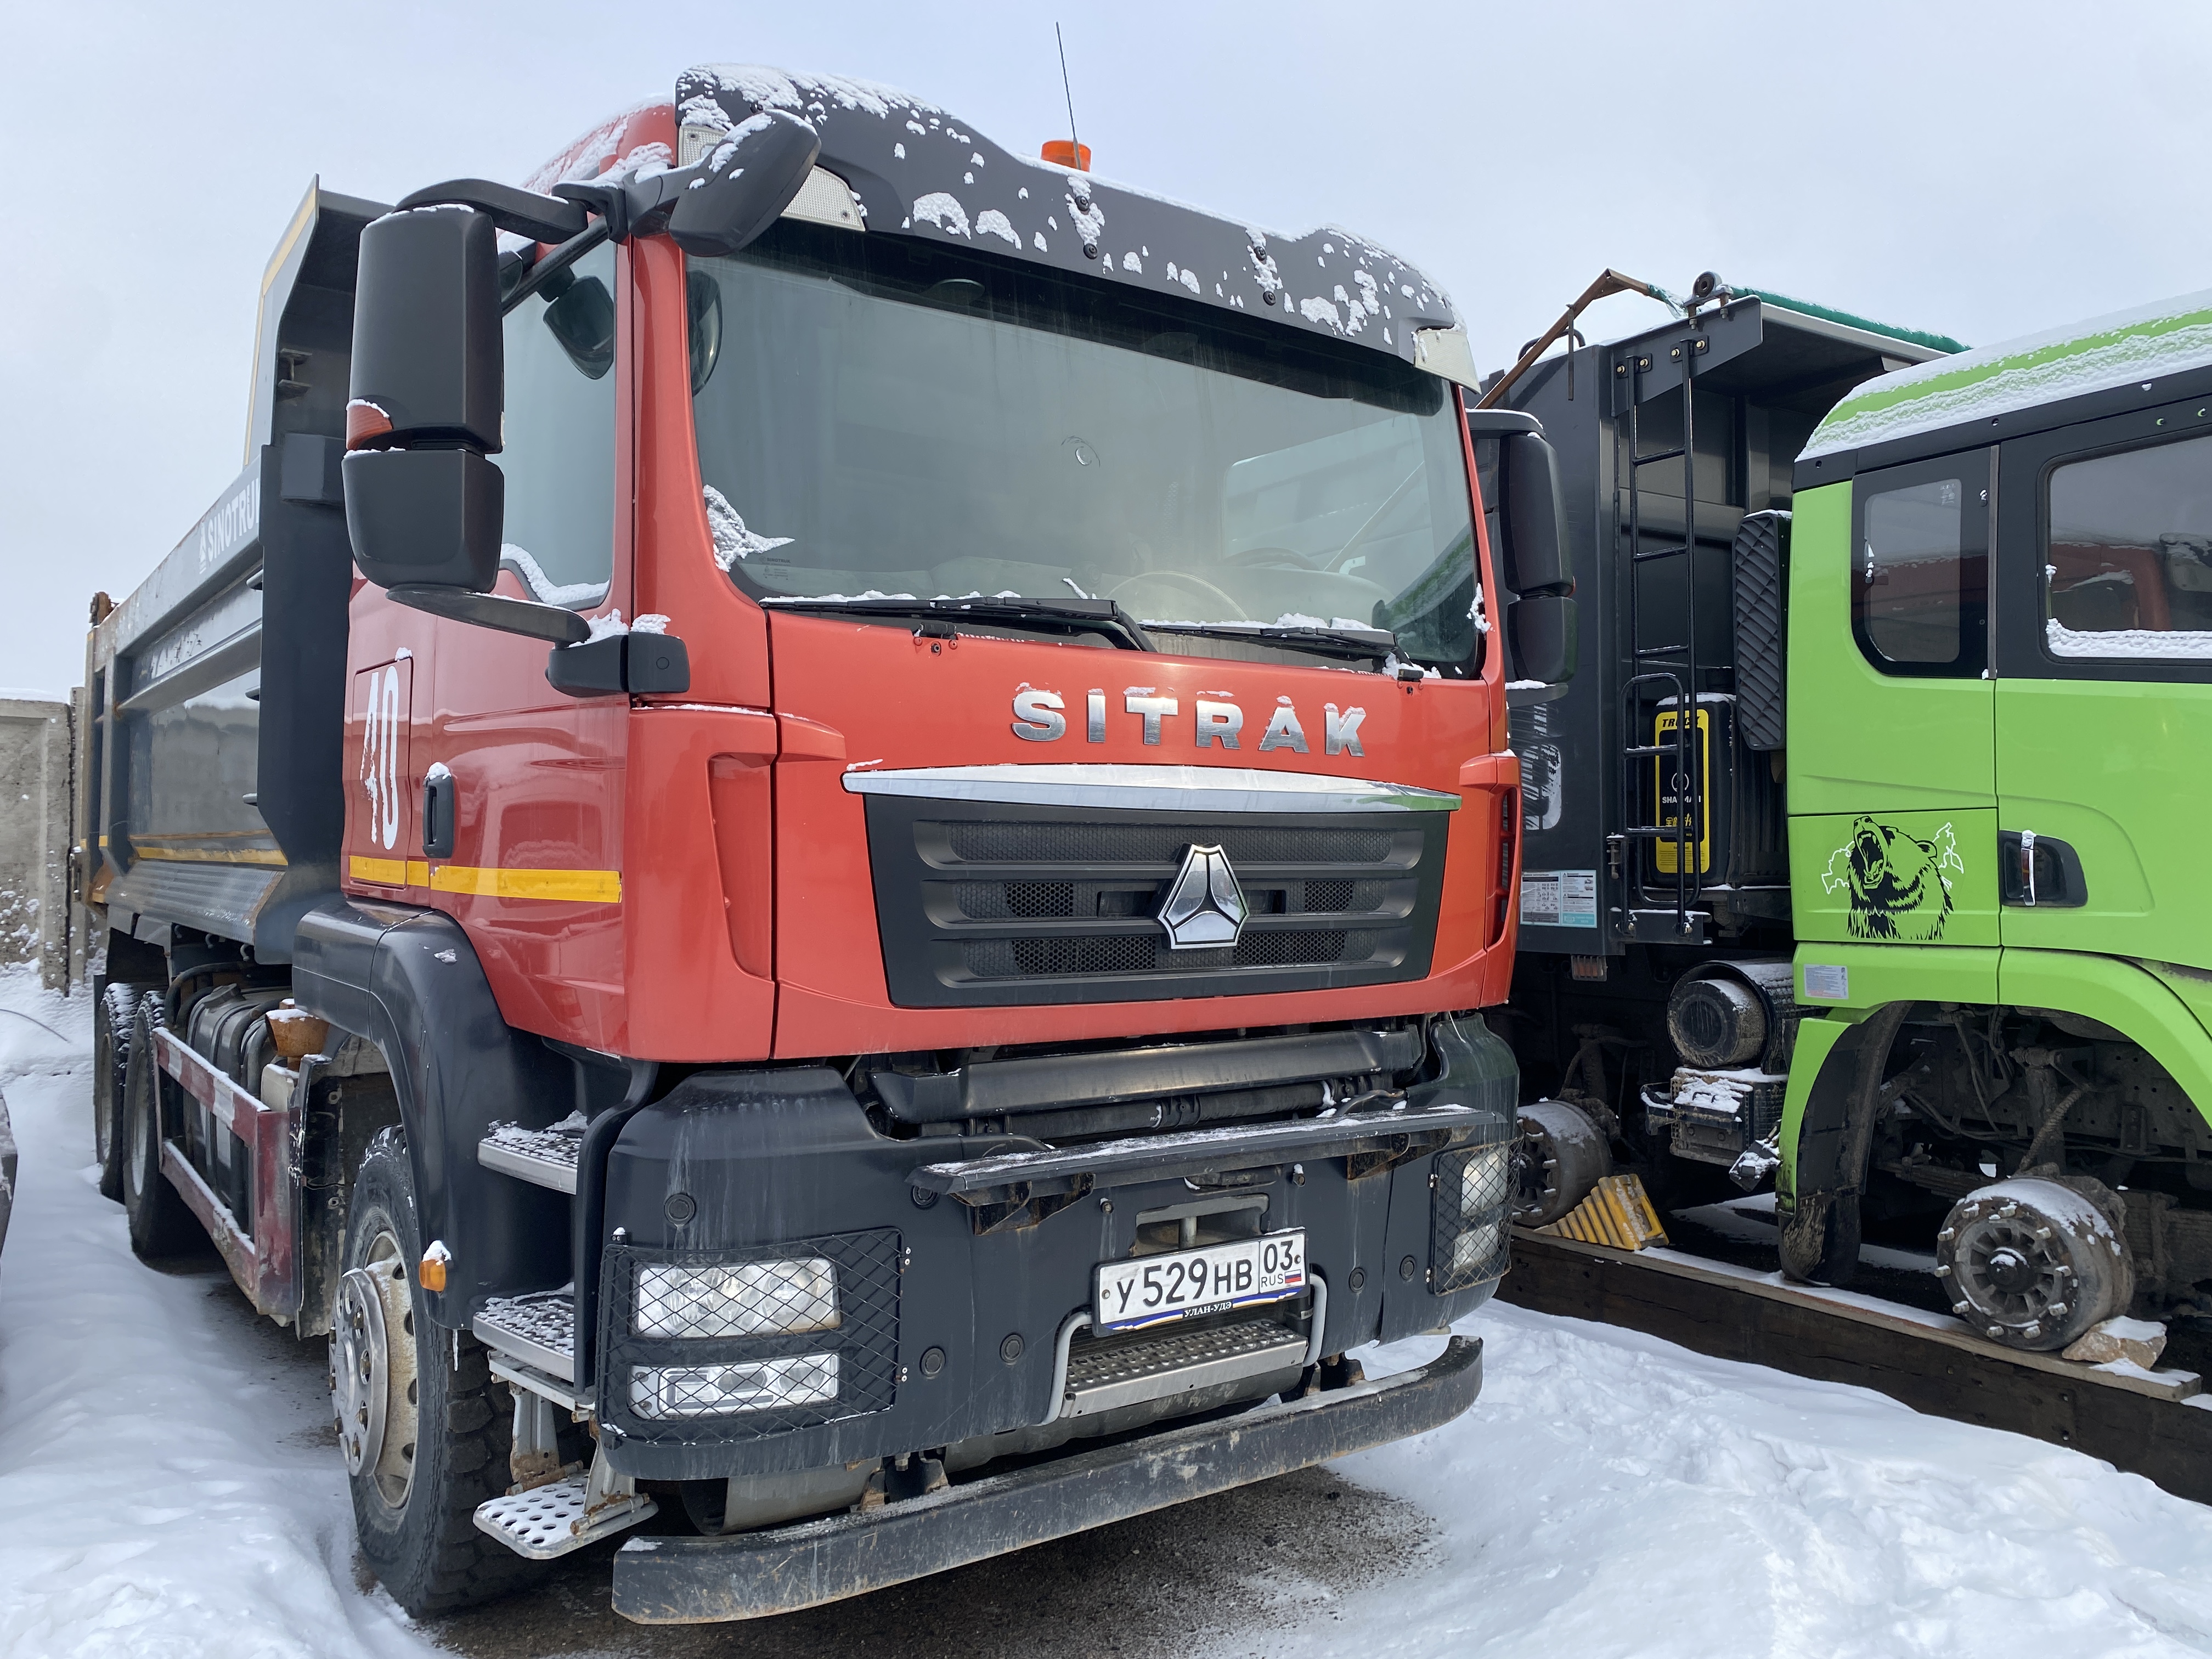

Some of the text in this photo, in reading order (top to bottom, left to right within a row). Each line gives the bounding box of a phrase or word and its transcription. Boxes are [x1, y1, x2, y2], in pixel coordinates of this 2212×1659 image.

[1011, 690, 1367, 757] SITRAK
[1263, 1240, 1294, 1273] 03
[1261, 1273, 1284, 1288] RUS
[1184, 1301, 1232, 1318] УЛАН-УДЭ
